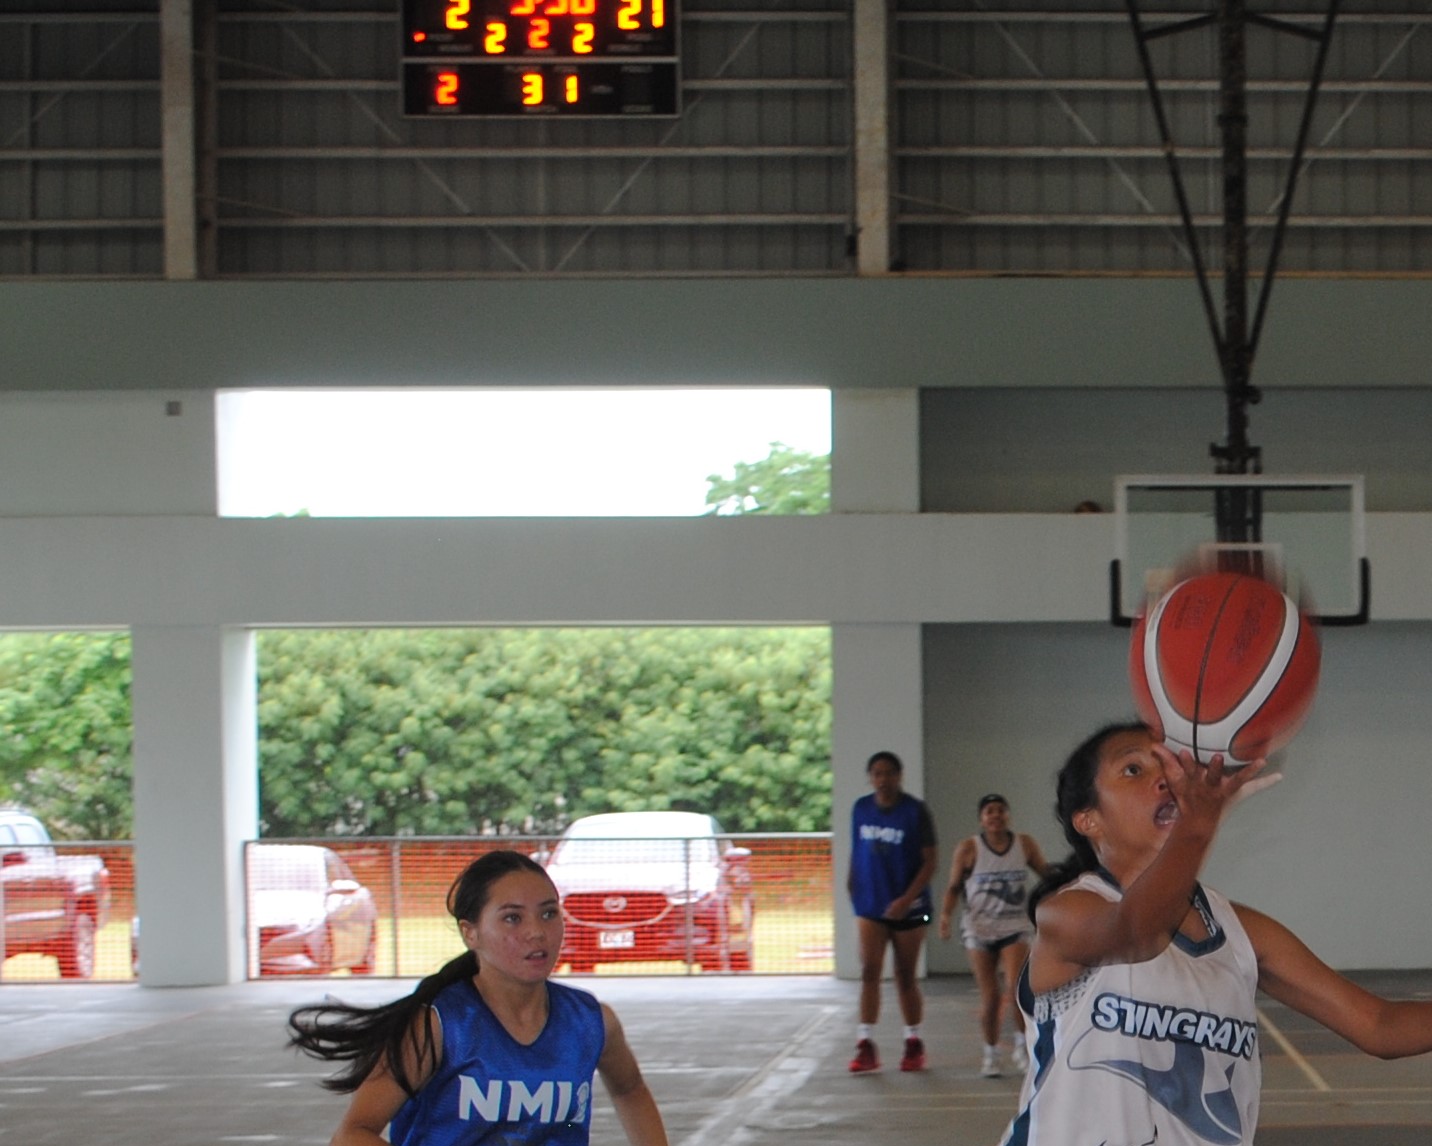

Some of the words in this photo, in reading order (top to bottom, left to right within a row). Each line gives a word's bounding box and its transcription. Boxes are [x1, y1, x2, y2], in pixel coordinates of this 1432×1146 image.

[484, 23, 507, 53] 2
[527, 19, 550, 48] 2
[571, 23, 595, 53] 2
[436, 73, 459, 105] 2
[1091, 992, 1256, 1060] STINGRAYS
